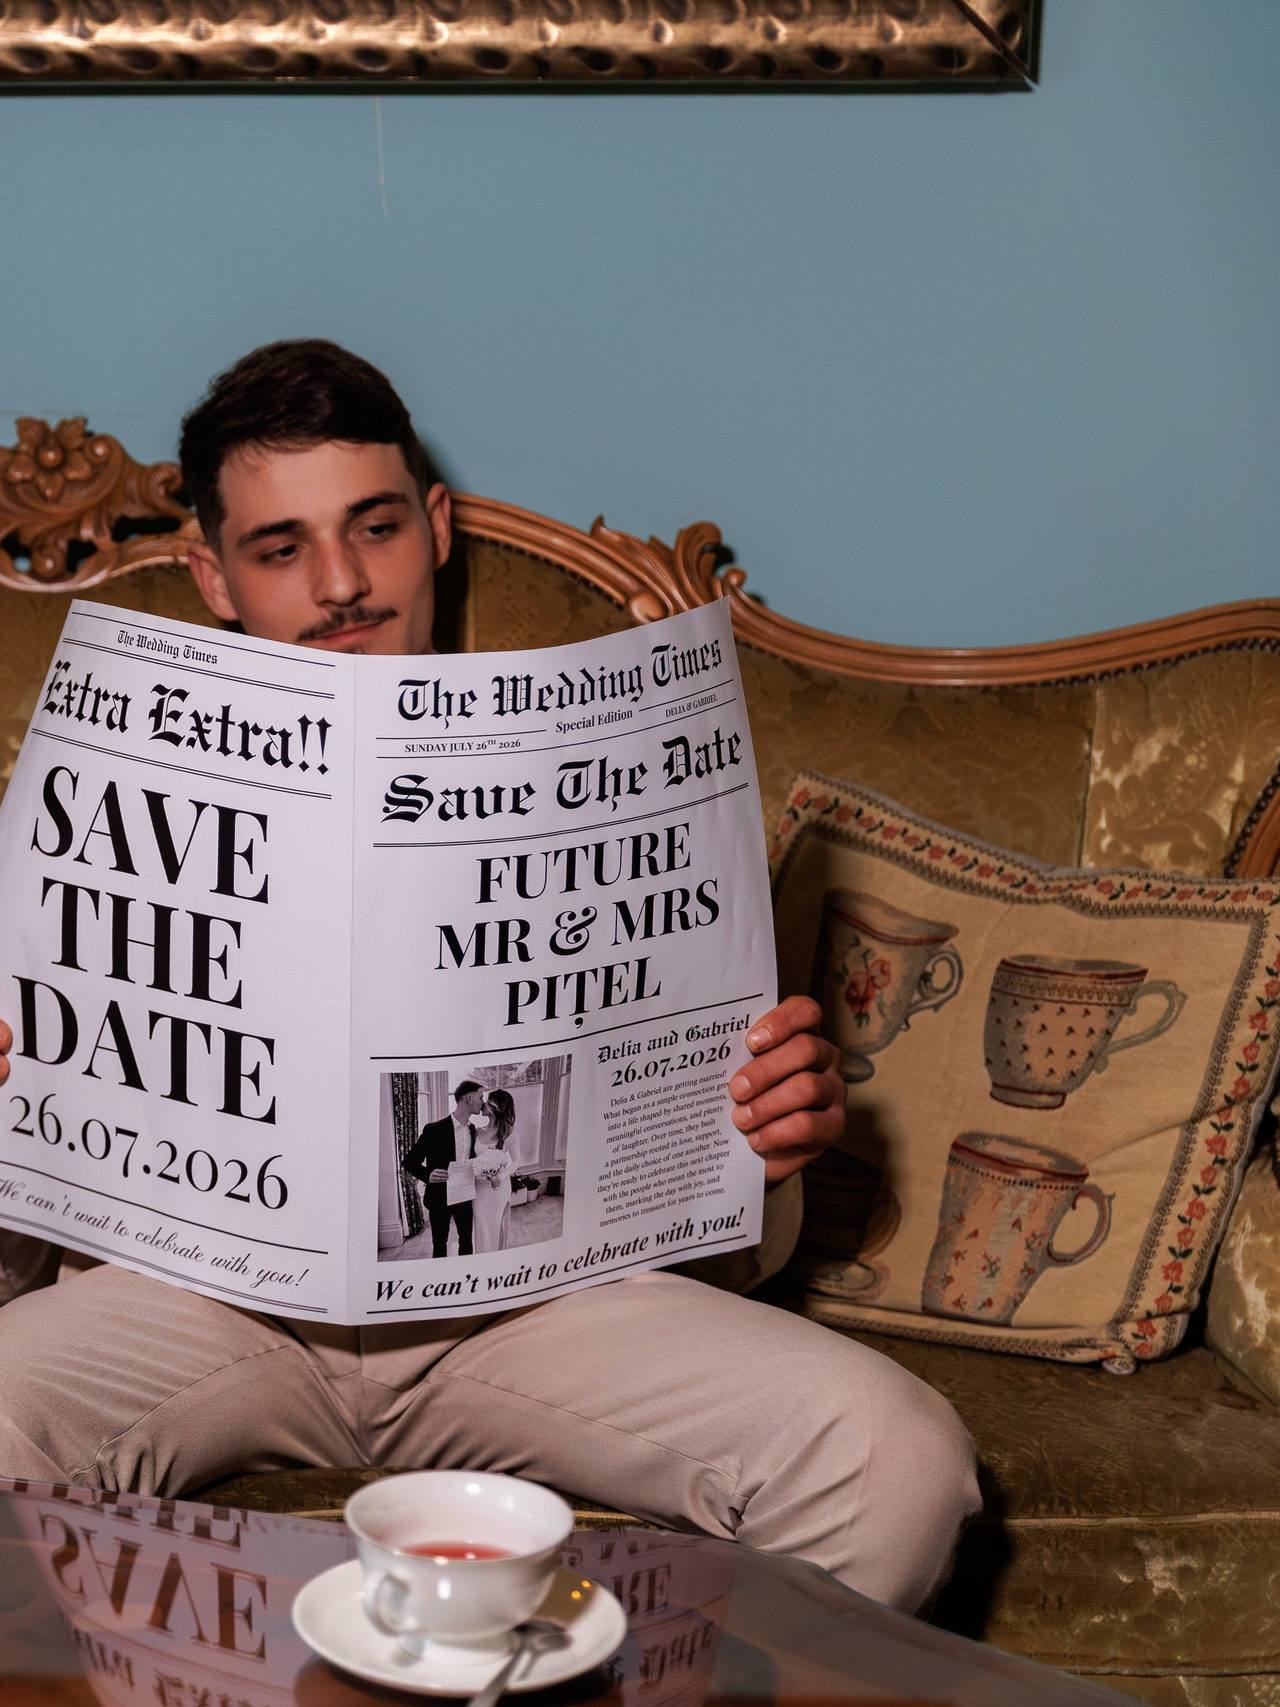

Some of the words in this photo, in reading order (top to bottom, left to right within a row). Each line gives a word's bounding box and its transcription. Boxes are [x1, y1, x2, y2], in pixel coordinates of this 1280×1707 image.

[117, 629, 135, 648] The
[136, 634, 180, 660] Wedding
[183, 644, 218, 664] Times
[397, 677, 478, 729] The
[491, 663, 644, 717] Wedding
[650, 637, 722, 687] Times
[41, 659, 132, 734] Extra
[148, 683, 333, 775] Extra!!
[555, 714, 595, 734] Special
[597, 709, 633, 726] Edition
[665, 704, 686, 718] DELIA
[686, 702, 692, 711] &
[692, 693, 718, 710] GABRIEL
[405, 743, 448, 753] SUNDAY
[449, 742, 474, 753] JULY
[498, 738, 521, 749] 2026
[380, 773, 537, 824] Save
[555, 755, 649, 812] The
[662, 726, 743, 790] Date
[30, 765, 269, 904] SAVE
[475, 822, 691, 904] FUTURE
[41, 876, 243, 1009] THE
[434, 917, 535, 970] MR
[549, 905, 598, 956] &
[610, 877, 720, 947] MRS
[12, 974, 276, 1125] DATE
[597, 1039, 642, 1065] Delia
[647, 1030, 679, 1049] and
[685, 1013, 750, 1043] Gabriel
[611, 1038, 732, 1087] 26.07.2026
[603, 1111, 620, 1120] What
[622, 1105, 641, 1116] began
[656, 1094, 678, 1105] simple
[679, 1085, 715, 1100] connection
[610, 1096, 628, 1107] Delia
[637, 1086, 662, 1099] Gabriel
[662, 1085, 673, 1093] are
[674, 1079, 697, 1091] getting
[699, 1070, 727, 1083] married!
[606, 1127, 642, 1144] meaningful
[643, 1115, 688, 1133] conversations,
[689, 1110, 702, 1120] and
[703, 1105, 724, 1118] plenty
[607, 1122, 621, 1131] into
[628, 1116, 638, 1126] life
[640, 1109, 662, 1122] shaped
[663, 1107, 671, 1116] by
[673, 1100, 695, 1112] shared
[696, 1094, 727, 1107] moments,
[9, 1093, 289, 1210] 26.07.2026
[610, 1149, 648, 1167] partnership
[648, 1141, 670, 1154] rooted
[671, 1140, 677, 1148] in
[679, 1137, 693, 1146] love,
[695, 1129, 722, 1141] support,
[612, 1144, 621, 1153] of
[621, 1138, 650, 1151] laughter.
[651, 1132, 667, 1142] Over
[668, 1128, 684, 1137] time,
[685, 1123, 699, 1133] they
[701, 1118, 716, 1128] built
[597, 1182, 619, 1193] they're
[620, 1176, 638, 1186] ready
[639, 1173, 646, 1181] to
[647, 1165, 676, 1178] celebrate
[677, 1161, 689, 1169] this
[705, 1151, 730, 1162] chapter
[598, 1171, 611, 1181] and
[612, 1169, 623, 1177] the
[624, 1163, 640, 1174] daily
[641, 1157, 662, 1168] choice
[663, 1153, 671, 1162] of
[672, 1151, 684, 1159] one
[685, 1143, 711, 1156] another.
[713, 1139, 730, 1148] Now
[603, 1193, 618, 1203] with
[619, 1190, 629, 1198] the
[630, 1183, 652, 1197] people
[652, 1178, 667, 1188] who
[668, 1174, 685, 1184] mean
[687, 1170, 697, 1178] the
[698, 1165, 715, 1175] most
[605, 1204, 624, 1214] them,
[625, 1195, 653, 1208] marking
[653, 1191, 664, 1199] the
[665, 1187, 677, 1196] day
[678, 1182, 692, 1192] with
[693, 1180, 705, 1190] joy,
[707, 1175, 720, 1185] and
[600, 1213, 631, 1227] memories
[632, 1210, 639, 1218] to
[640, 1202, 666, 1215] treasure
[667, 1198, 677, 1207] for
[678, 1195, 695, 1205] years
[696, 1191, 704, 1199] to
[705, 1187, 725, 1197] come.
[25, 1194, 72, 1218] can't
[73, 1206, 111, 1232] wait
[113, 1219, 129, 1238] to
[135, 1226, 205, 1263] celebrate
[211, 1252, 250, 1277] with
[250, 1268, 310, 1289] you!
[375, 1279, 414, 1302] We
[421, 1273, 480, 1297] can't
[486, 1265, 533, 1291] wait
[537, 1262, 557, 1280] to
[563, 1232, 649, 1274] celebrate
[654, 1217, 695, 1247] with
[698, 1206, 745, 1241] you!
